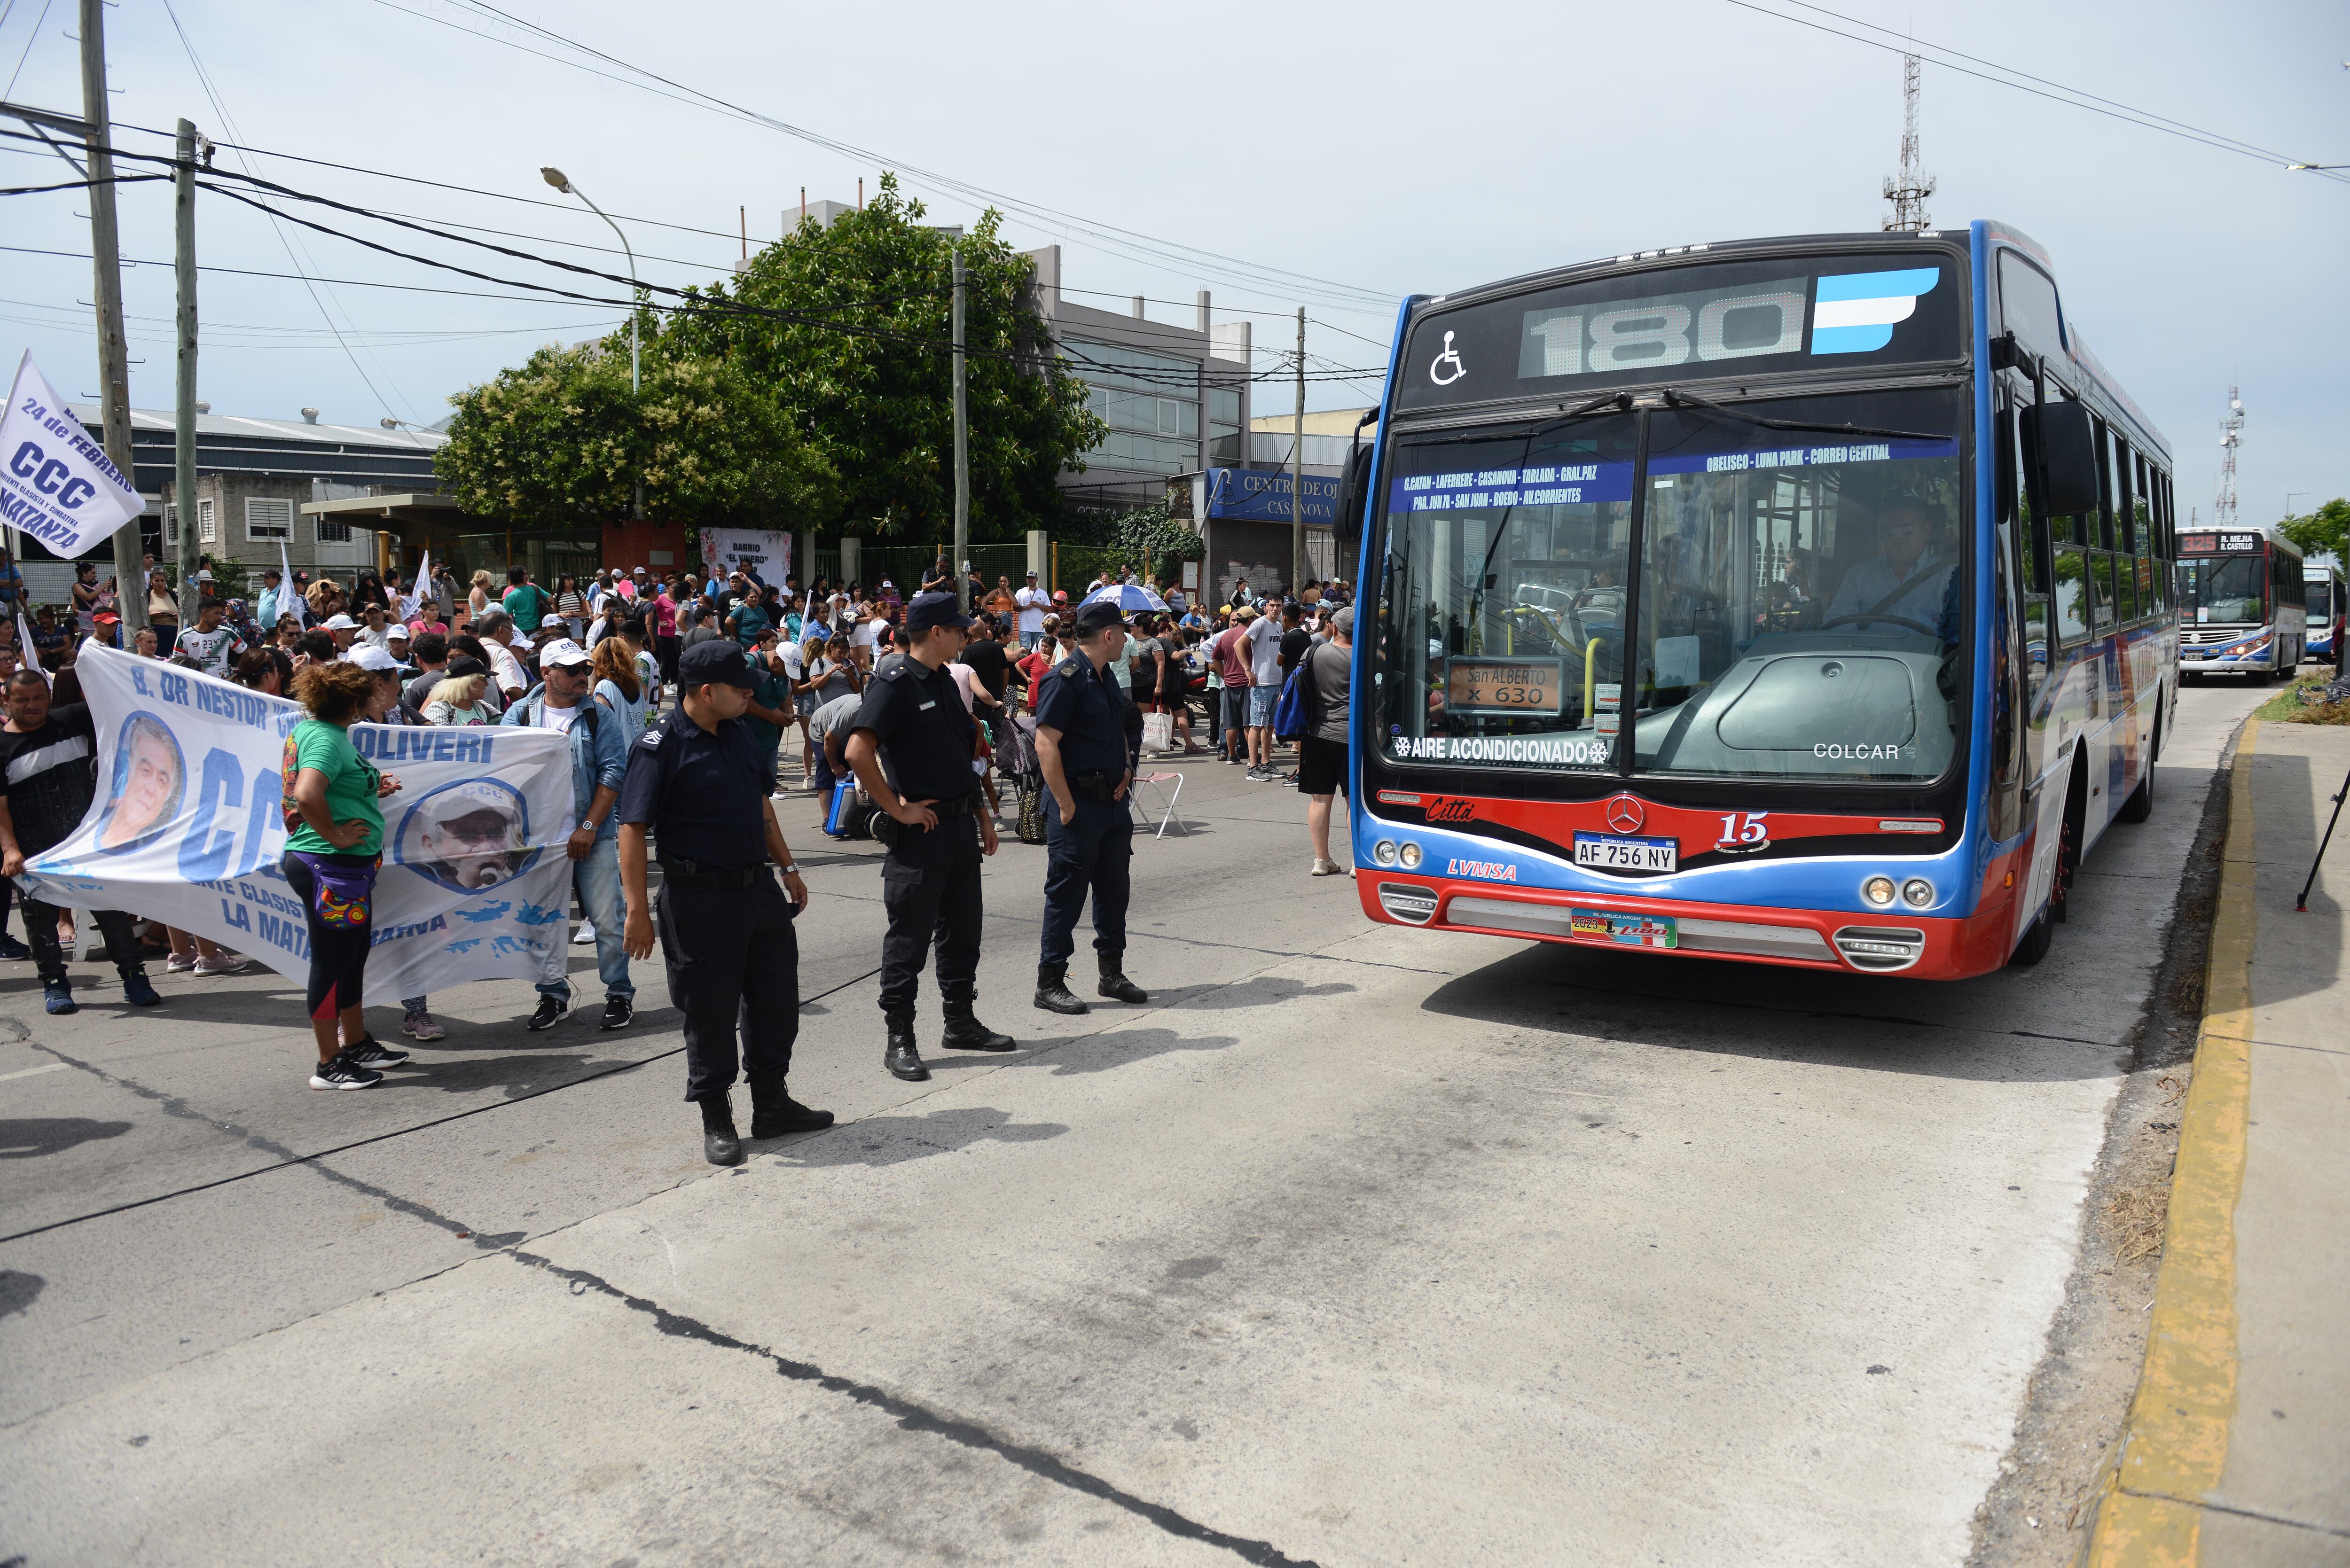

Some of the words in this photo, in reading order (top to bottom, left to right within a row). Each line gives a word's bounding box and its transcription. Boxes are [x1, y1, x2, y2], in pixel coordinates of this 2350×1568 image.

[1531, 292, 1805, 376] 180
[22, 398, 47, 421] 24
[43, 417, 69, 438] de
[1707, 454, 1748, 472] OBELISCO
[1755, 452, 1778, 468] LUNA
[1780, 450, 1804, 467] PARK
[1810, 446, 1847, 464] CORREO
[1849, 444, 1890, 462] CENTRAL
[10, 441, 95, 509] CCC
[1404, 475, 1432, 491] G.CATAN
[1436, 473, 1473, 489] LAFERRERE
[1478, 469, 1516, 486] CASANOVA
[1522, 467, 1555, 484] TABLADA
[1560, 465, 1597, 482] GRAL.PAZ
[1304, 481, 1321, 496] DE
[1413, 496, 1428, 510] PRA.
[1455, 492, 1469, 508] SAN
[1470, 491, 1488, 507] JUAN
[1493, 490, 1519, 506] BOEDO
[1523, 488, 1581, 505] AV.CORRIENTES
[19, 485, 45, 506] CLASISTA
[49, 506, 78, 527] COMBATIVA
[1268, 500, 1331, 517] CASNOVA
[0, 487, 80, 549] MATANZA
[733, 543, 760, 552] BARRIO
[2183, 536, 2216, 552] 325
[203, 640, 213, 649] 23
[792, 658, 802, 666] CC
[1467, 667, 1488, 683] San
[1491, 668, 1546, 686] ALBERTO
[1495, 687, 1543, 704] 630
[131, 665, 155, 698] B.
[160, 670, 189, 706] DR
[193, 680, 267, 731] NESTOR
[352, 726, 494, 764] OLIVERI
[1411, 737, 1446, 758] AIRE
[1449, 739, 1588, 764] ACONDICIONADO
[1814, 743, 1899, 759] COLCAR
[462, 786, 503, 799] CCC
[1718, 811, 1768, 843] 15
[1580, 843, 1601, 862] AF
[1608, 845, 1641, 865] 756
[1648, 848, 1671, 867] NY
[1447, 858, 1517, 882] LVMSA
[221, 898, 251, 933] LA
[1574, 918, 1598, 929] 2023
[1619, 925, 1669, 936] L180
